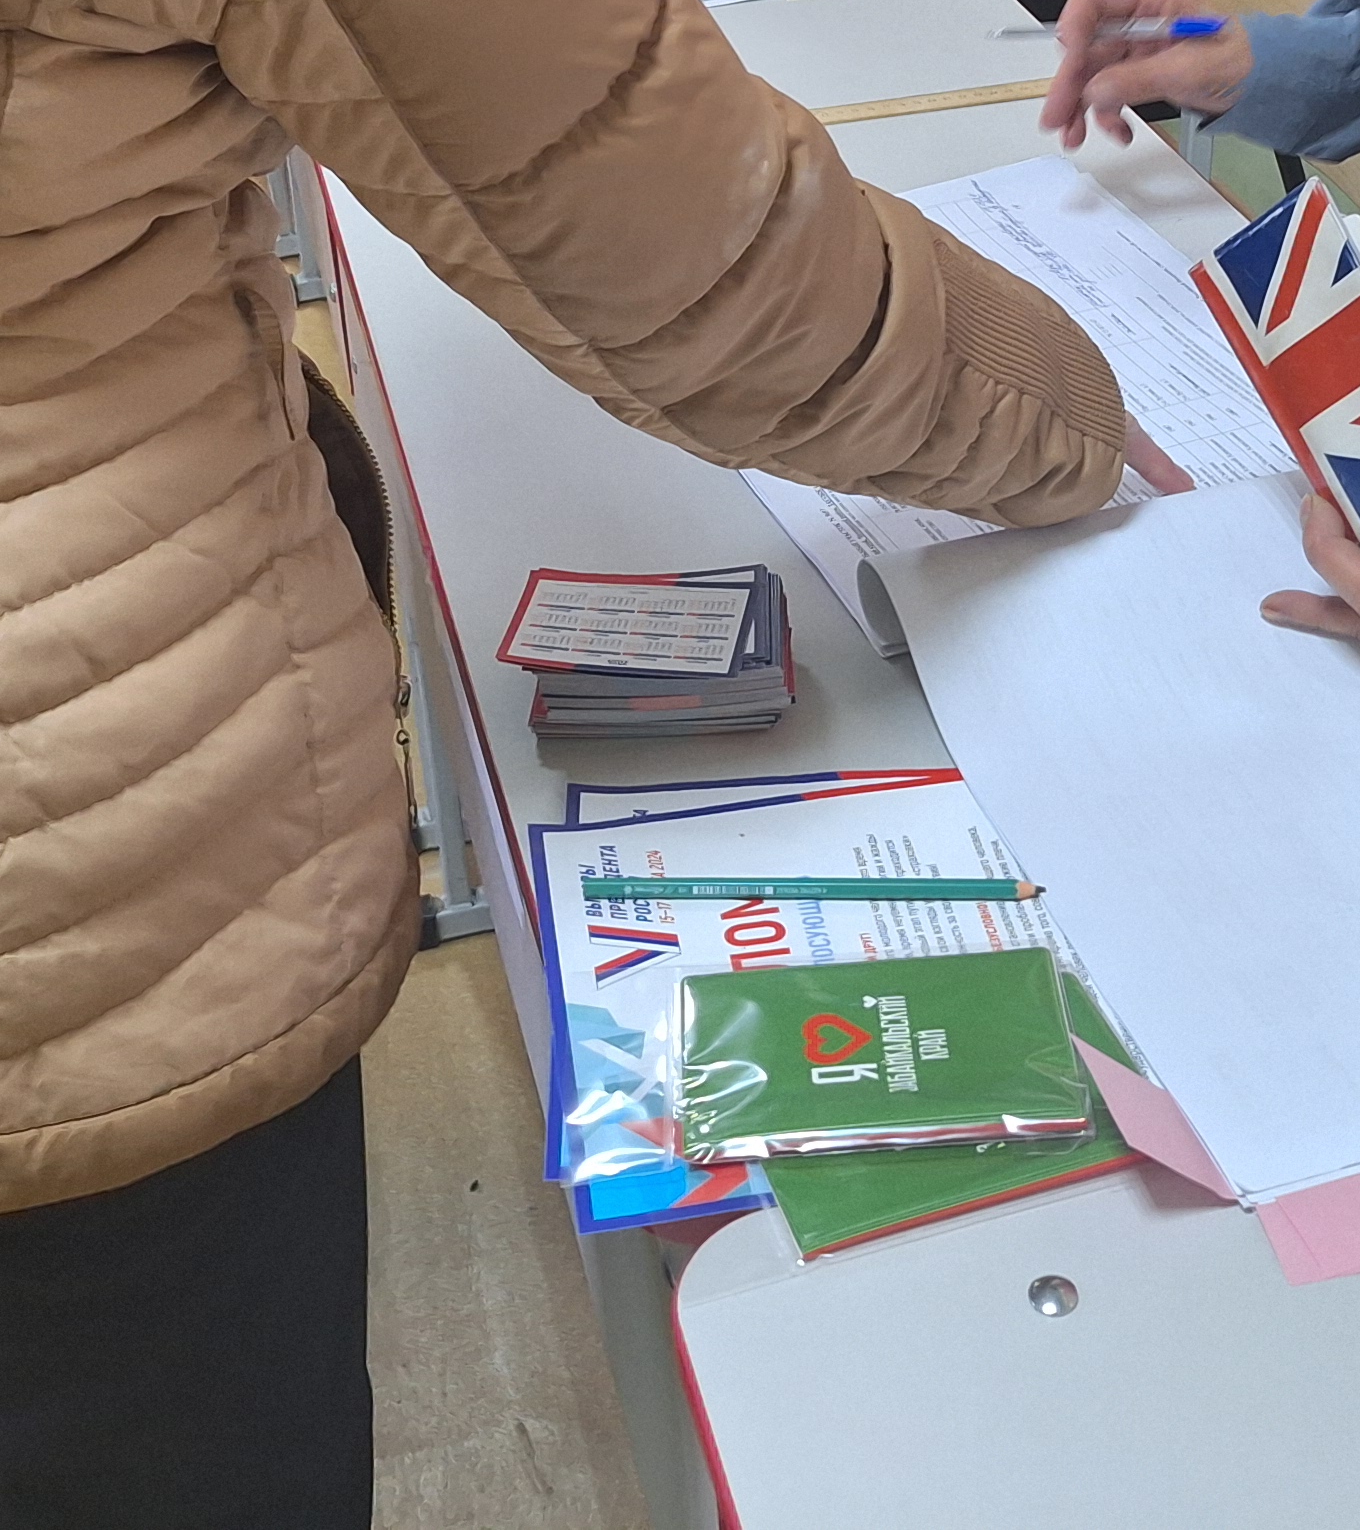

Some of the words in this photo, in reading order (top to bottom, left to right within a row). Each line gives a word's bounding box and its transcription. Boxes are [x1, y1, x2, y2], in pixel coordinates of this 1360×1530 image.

[646, 850, 665, 871] 2024
[599, 845, 629, 920] ПРЕДЕНТА
[876, 995, 919, 1093] ЗАБАЙКАЛЬСКИЙ
[913, 1029, 950, 1060] КРАЙ
[811, 1063, 879, 1085] Я
